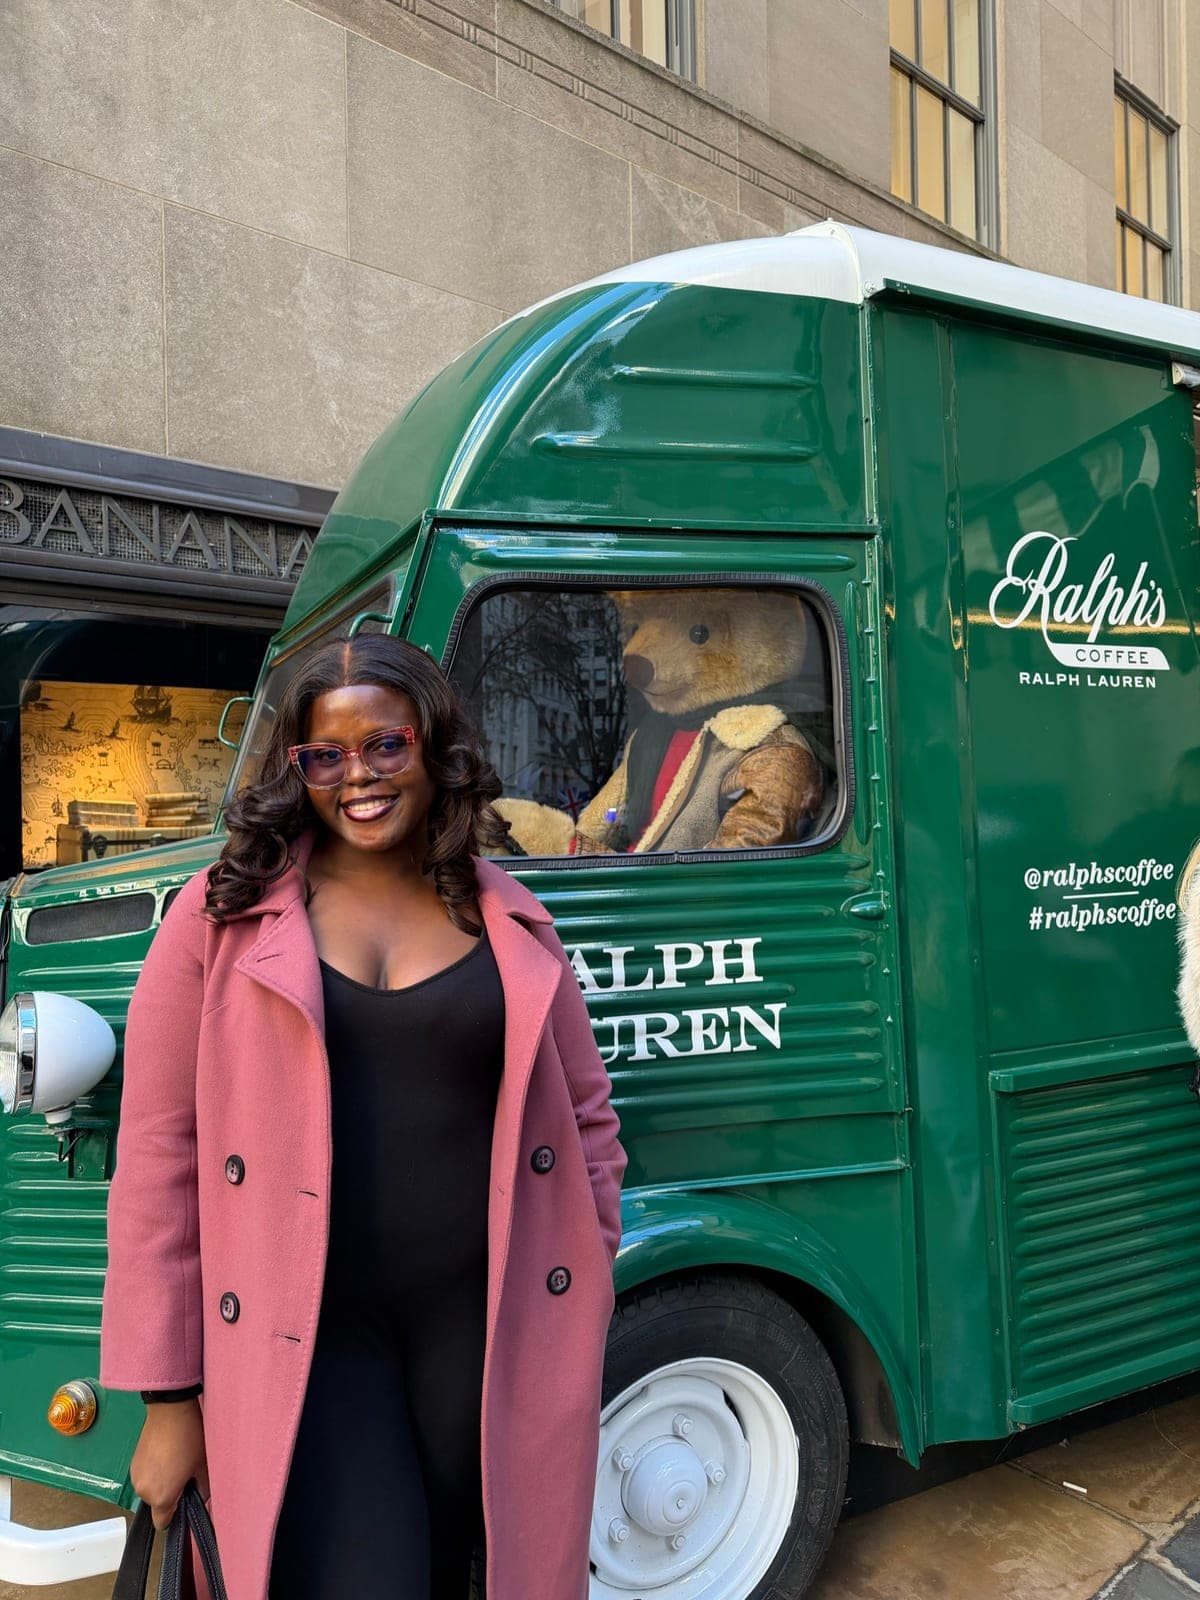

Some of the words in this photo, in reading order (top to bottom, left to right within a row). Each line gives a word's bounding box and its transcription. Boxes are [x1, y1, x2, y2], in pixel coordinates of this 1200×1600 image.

[989, 530, 1166, 644] Ralph's
[1075, 648, 1149, 665] COFFEE
[1019, 671, 1080, 687] RALPH
[1087, 675, 1156, 689] LAUREN
[1023, 858, 1174, 890] @ralphscoffee
[1029, 898, 1177, 932] #ralphscoffee
